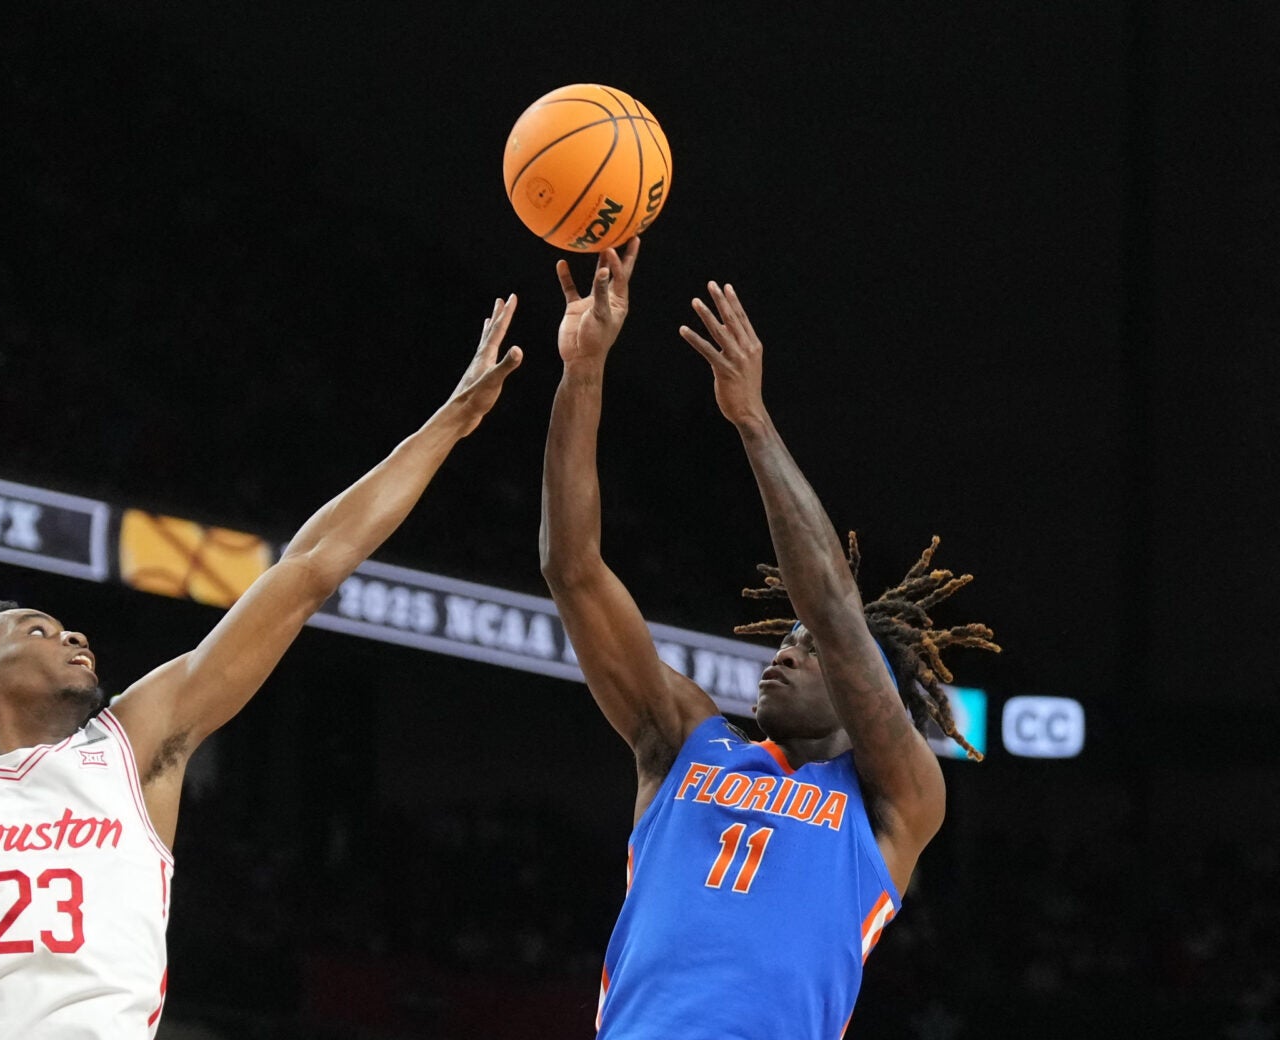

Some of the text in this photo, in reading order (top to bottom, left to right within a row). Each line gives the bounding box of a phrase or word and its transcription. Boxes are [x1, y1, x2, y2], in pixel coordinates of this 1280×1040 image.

[444, 595, 556, 661] NCAA
[1015, 710, 1071, 743] CC
[674, 762, 848, 831] FLORIDA
[704, 822, 774, 894] 11
